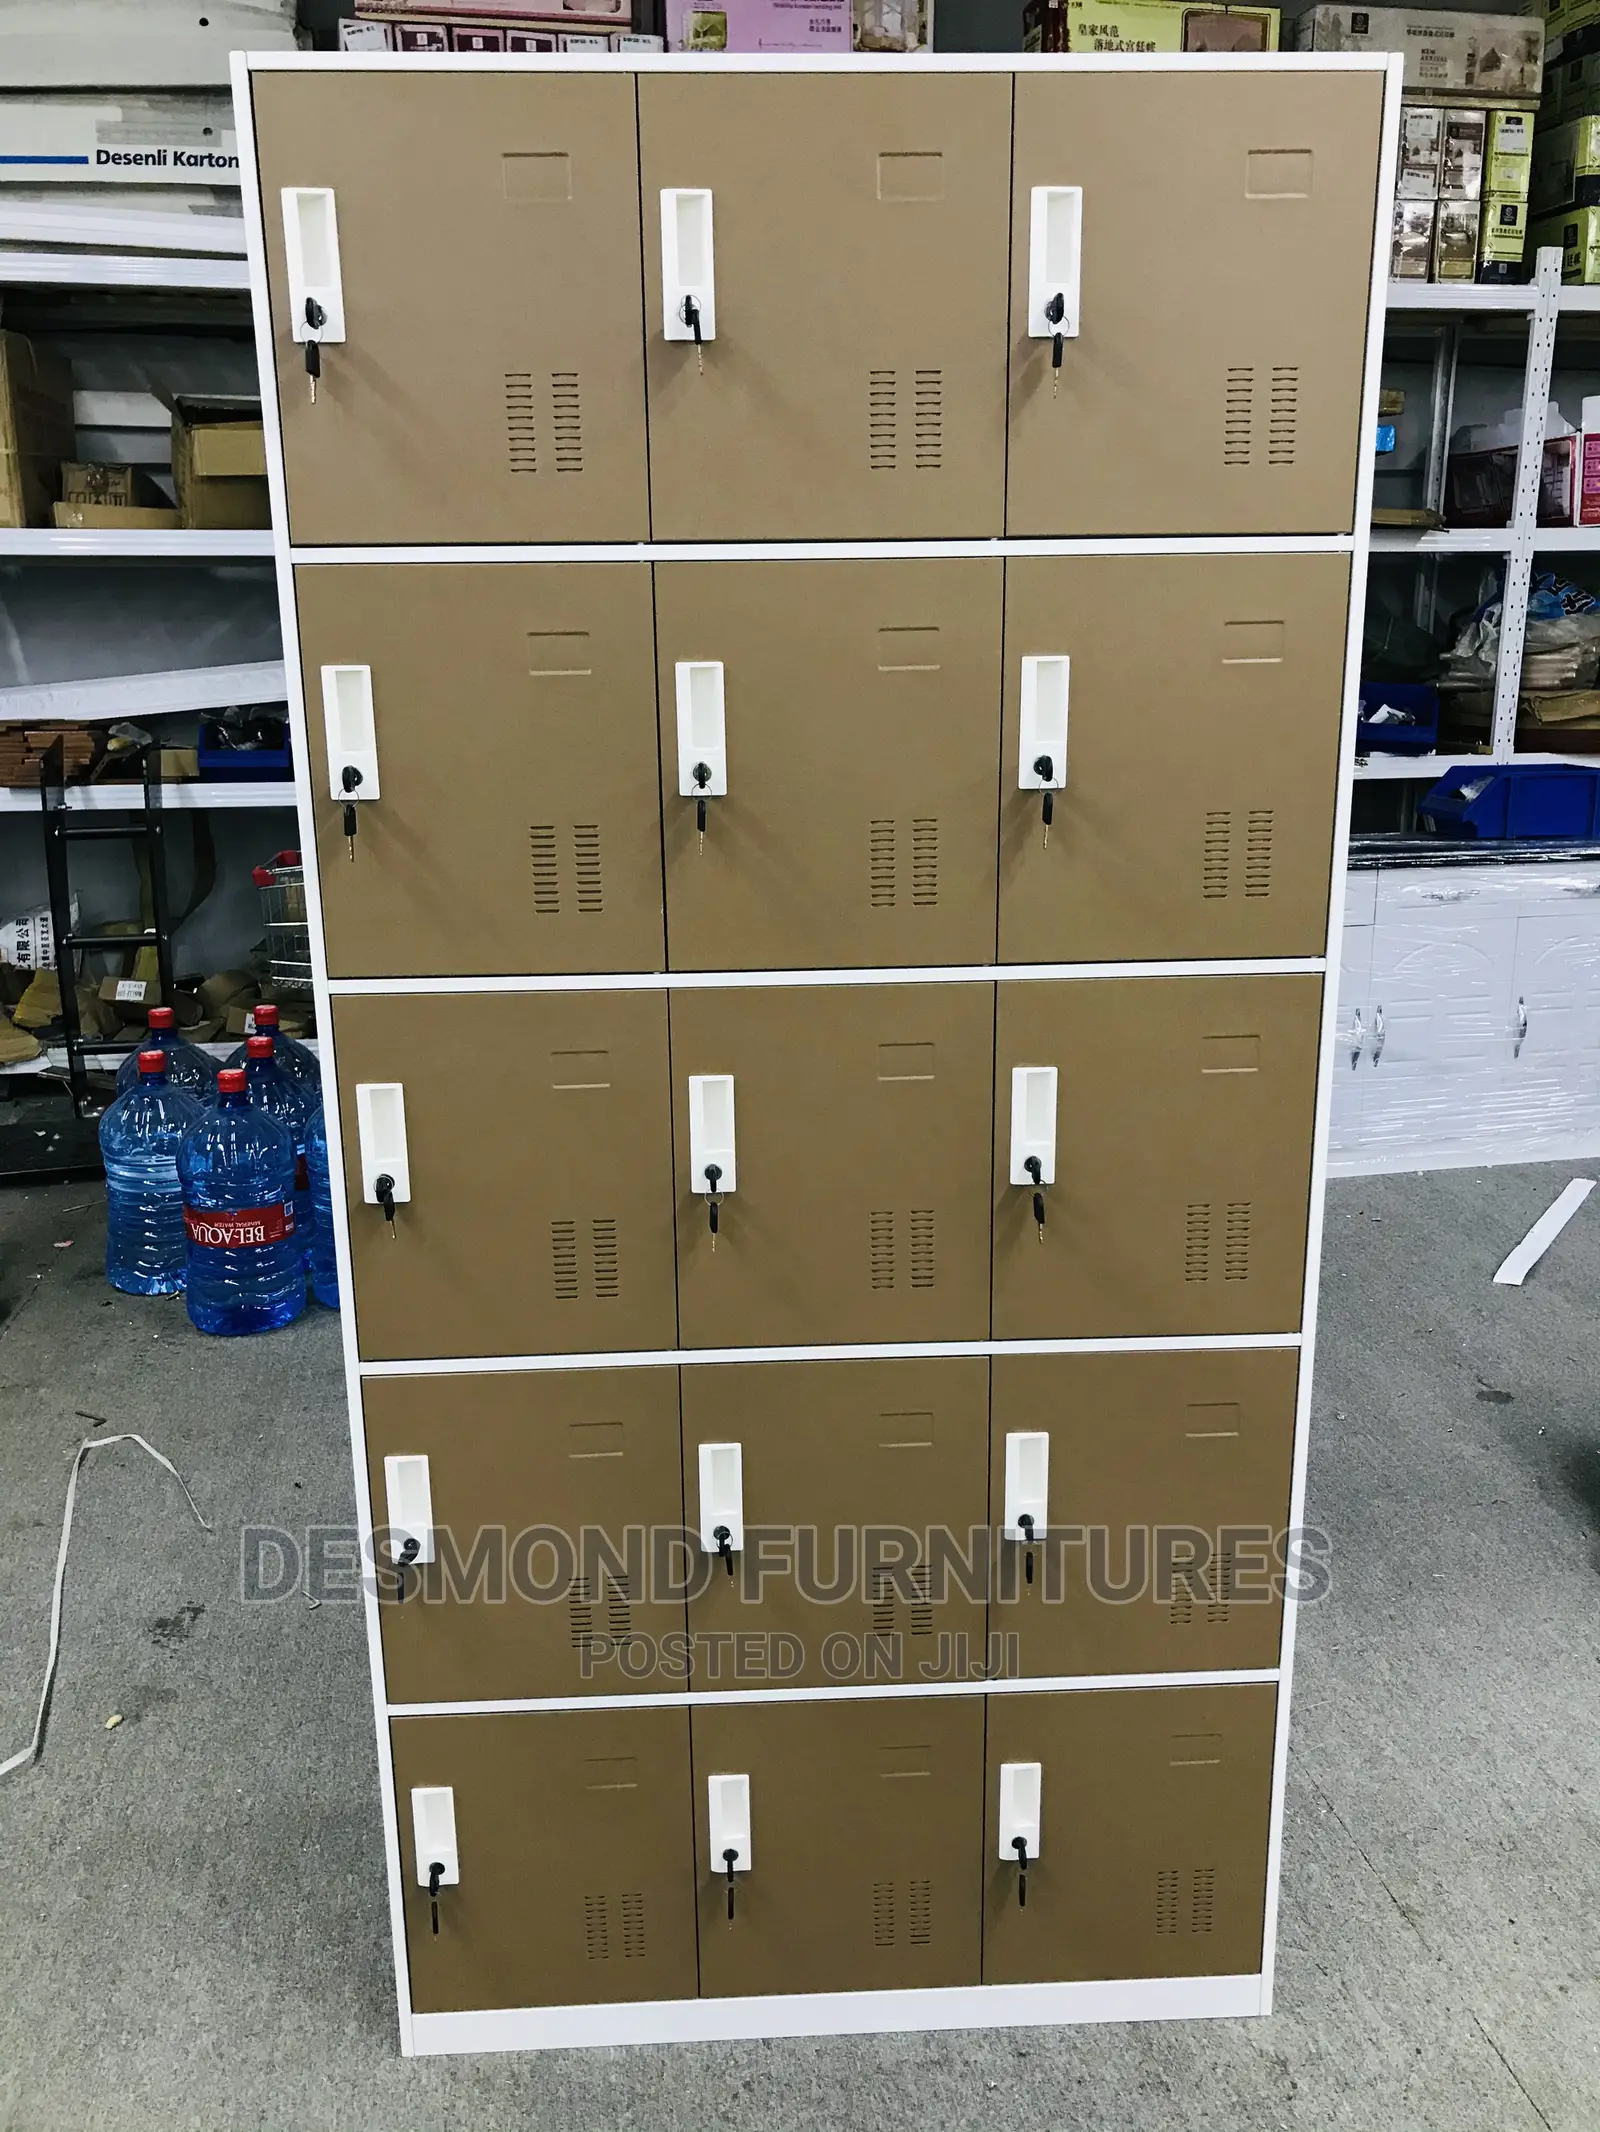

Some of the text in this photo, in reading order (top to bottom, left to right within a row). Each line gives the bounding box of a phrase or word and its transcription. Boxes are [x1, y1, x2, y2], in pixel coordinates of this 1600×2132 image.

[1078, 23, 1119, 38] 皇家风范
[96, 149, 239, 168] Desenli Karton
[234, 1220, 261, 1228] MINERAL
